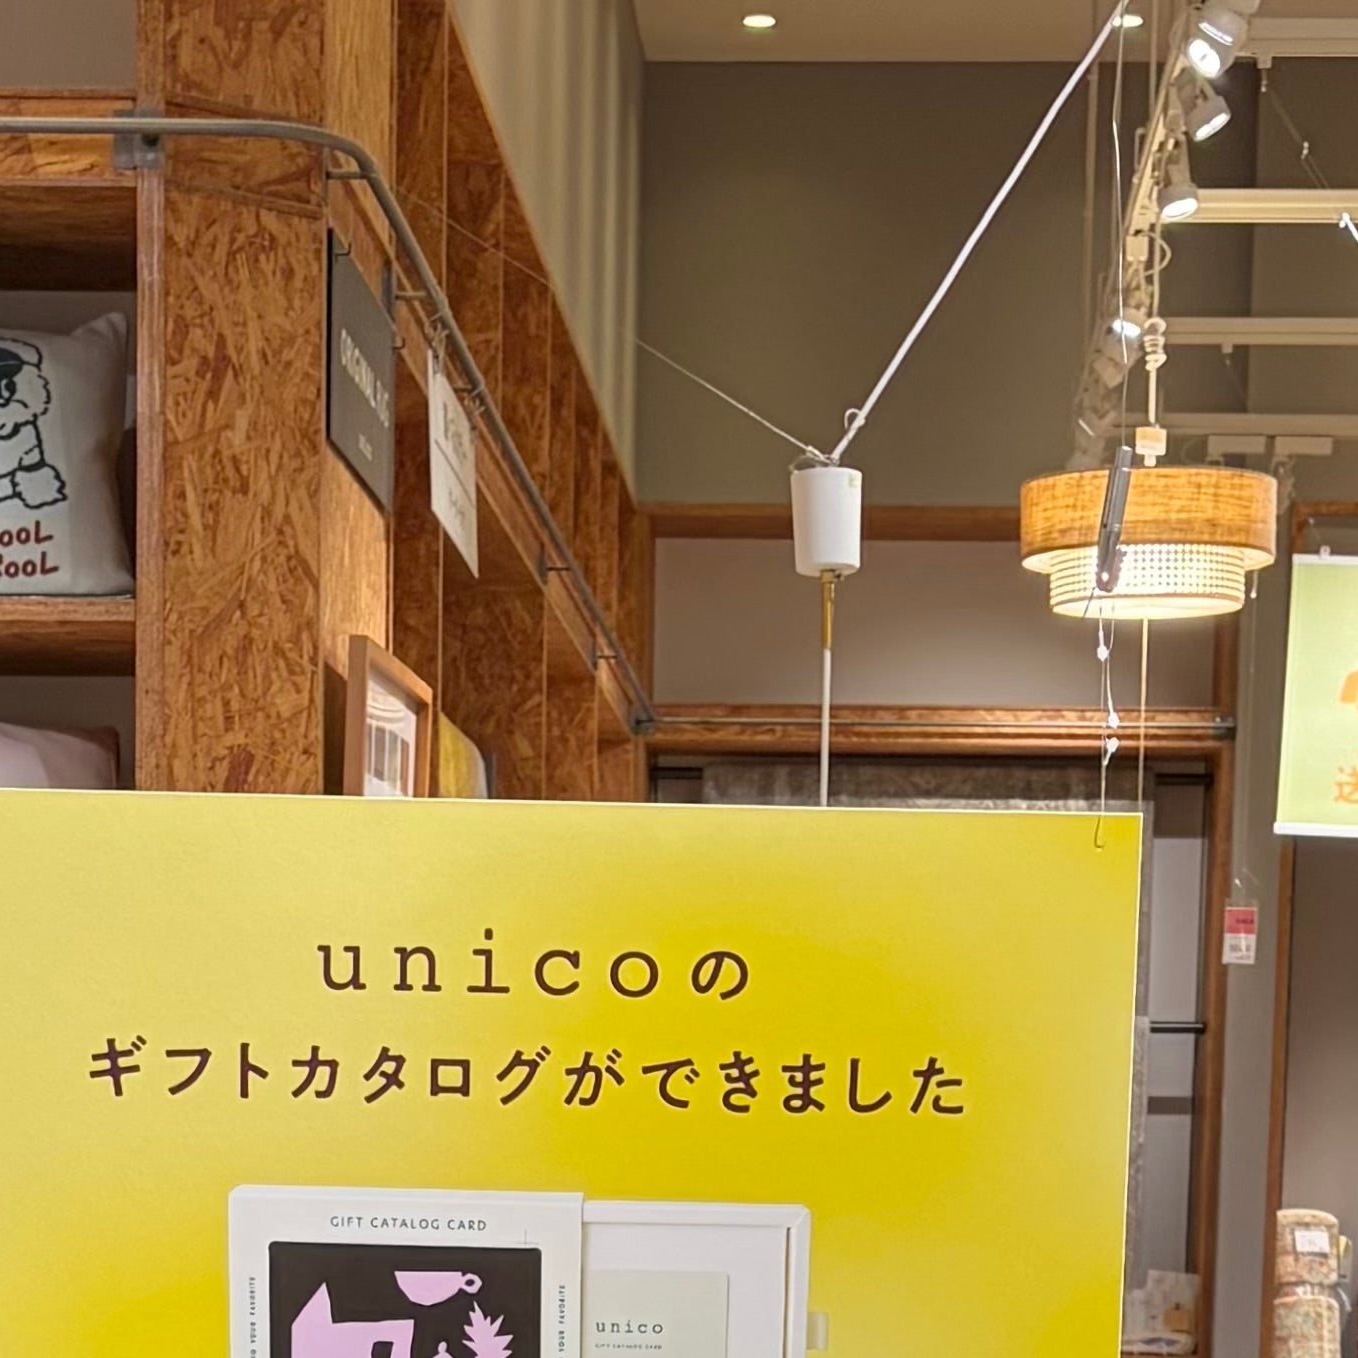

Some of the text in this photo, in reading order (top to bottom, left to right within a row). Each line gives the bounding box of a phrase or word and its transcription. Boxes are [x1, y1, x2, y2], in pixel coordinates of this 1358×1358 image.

[87, 1034, 968, 1118] ギフトカタログができました
[329, 1215, 488, 1232] GIFT CATALOG CARD
[595, 1318, 664, 1336] unico
